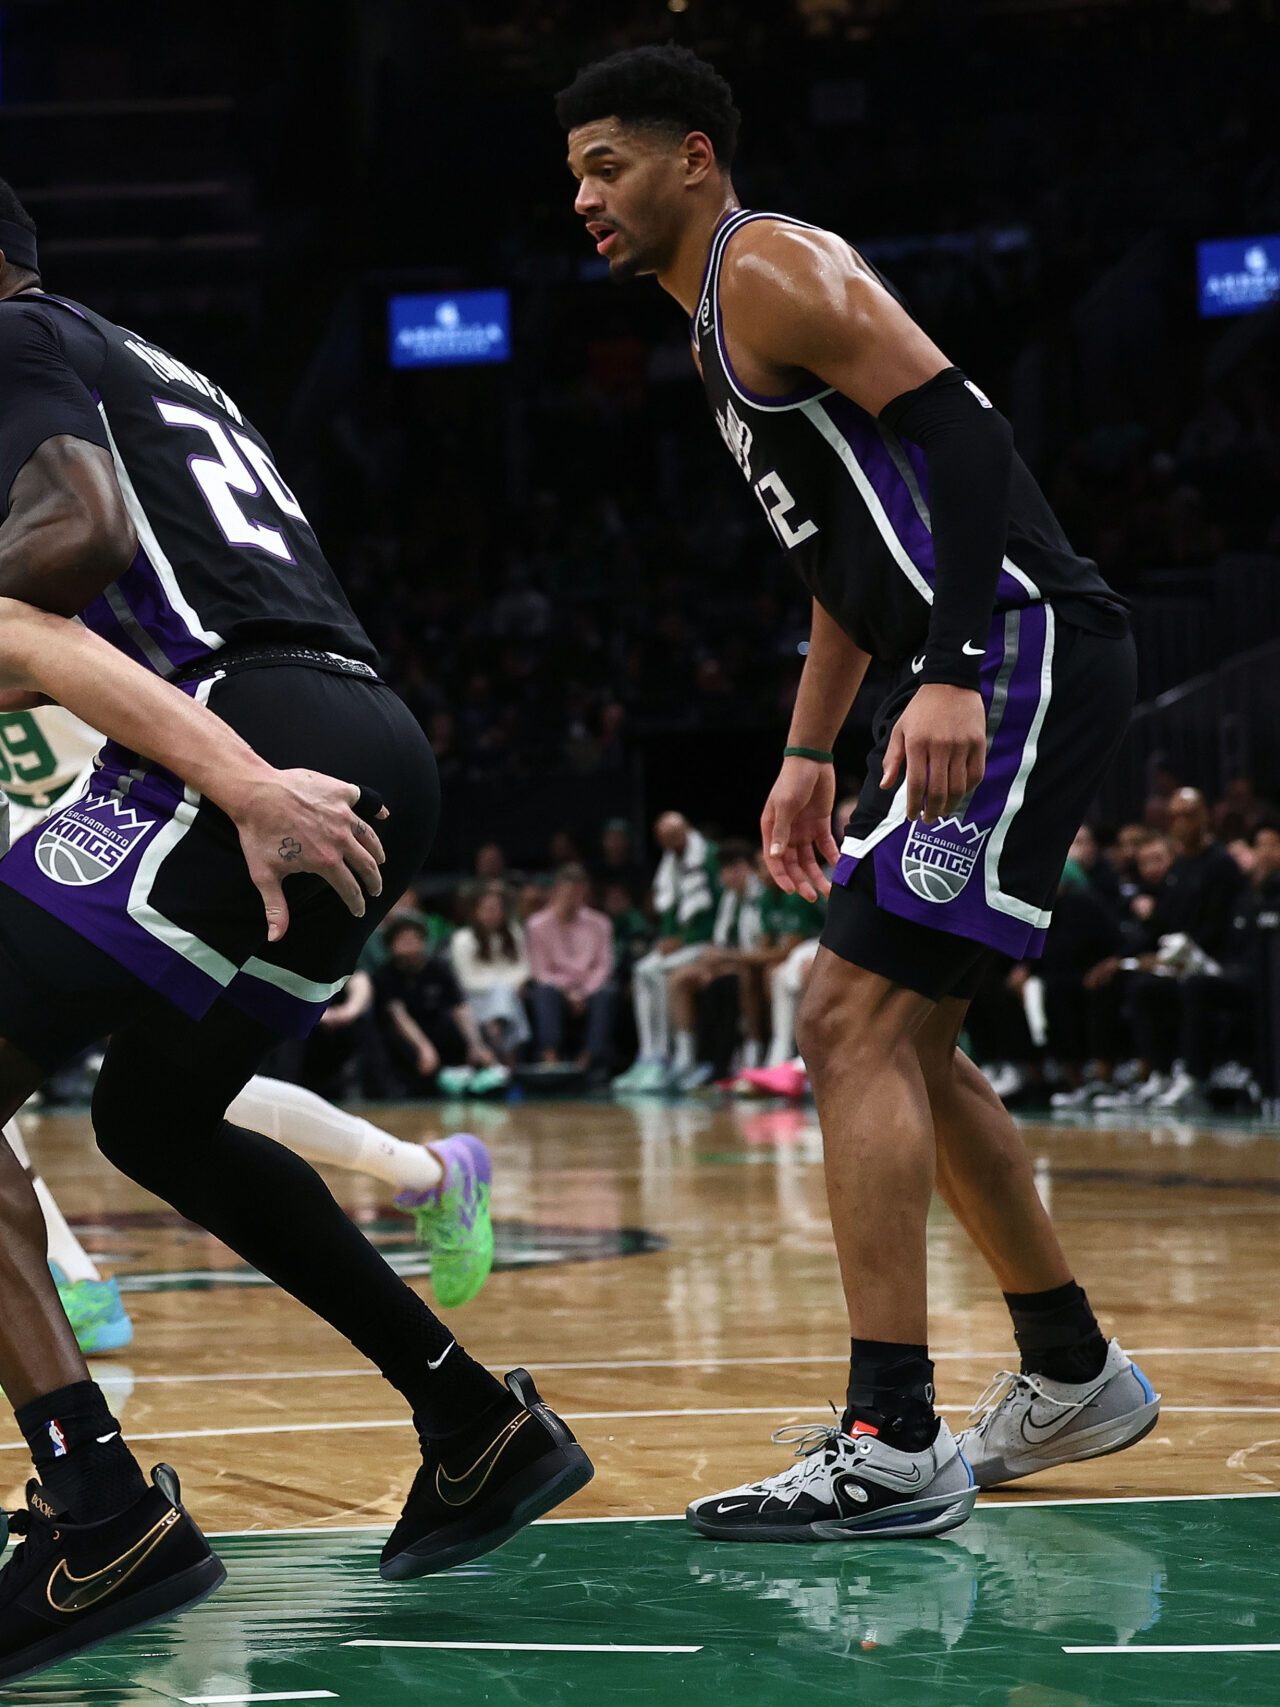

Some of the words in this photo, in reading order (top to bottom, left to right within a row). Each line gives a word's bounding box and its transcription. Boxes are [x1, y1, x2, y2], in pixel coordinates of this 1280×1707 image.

[754, 470, 819, 550] 2
[48, 819, 124, 869] KINGS
[66, 810, 130, 847] SACRAMENTO
[906, 841, 973, 877] KINGS
